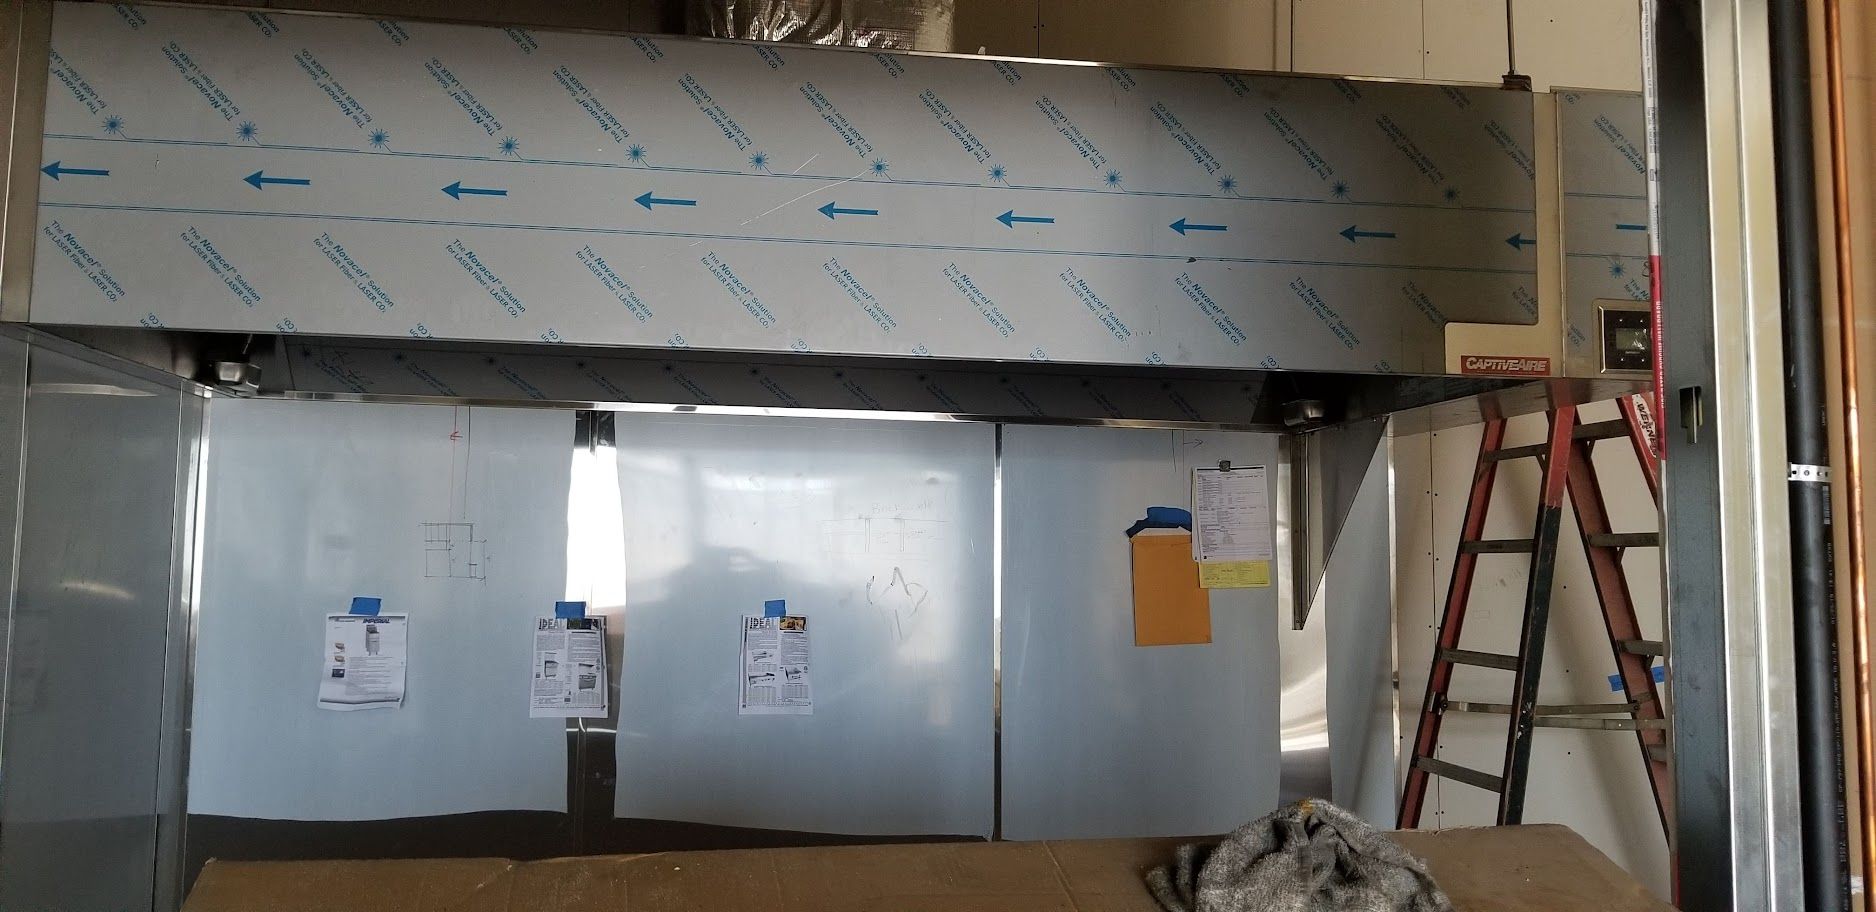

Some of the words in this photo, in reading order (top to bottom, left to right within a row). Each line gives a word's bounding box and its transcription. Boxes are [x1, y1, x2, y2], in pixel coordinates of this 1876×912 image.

[51, 219, 64, 235] The
[98, 268, 126, 297] Solution
[51, 235, 72, 255] LASER
[87, 271, 108, 292] LASER
[188, 225, 201, 241] The
[234, 274, 261, 302] Solution
[188, 240, 208, 261] LASER
[224, 277, 244, 297] LASER
[321, 231, 334, 246] The
[367, 280, 394, 307] Solution
[321, 246, 341, 267] LASER
[357, 282, 377, 303] LASER
[453, 238, 466, 253] The
[499, 285, 526, 313] Solution
[453, 253, 474, 273] LASER
[489, 288, 509, 308] LASER
[583, 244, 595, 259] The
[628, 291, 654, 318] Solution
[583, 259, 603, 279] LASER
[618, 294, 637, 314] LASER
[708, 250, 720, 265] The
[751, 297, 776, 323] Solution
[708, 265, 727, 284] LASER
[742, 299, 761, 319] LASER
[829, 256, 841, 271] The
[872, 302, 897, 328] Solution
[830, 270, 849, 290] LASER
[863, 304, 882, 324] LASER
[949, 261, 961, 276] The
[991, 307, 1016, 333] Solution
[949, 275, 968, 295] LASER
[982, 309, 1000, 328] LASER
[1066, 266, 1077, 280] The
[1107, 311, 1131, 337] Solution
[1066, 280, 1084, 299] LASER
[1098, 314, 1116, 333] LASER
